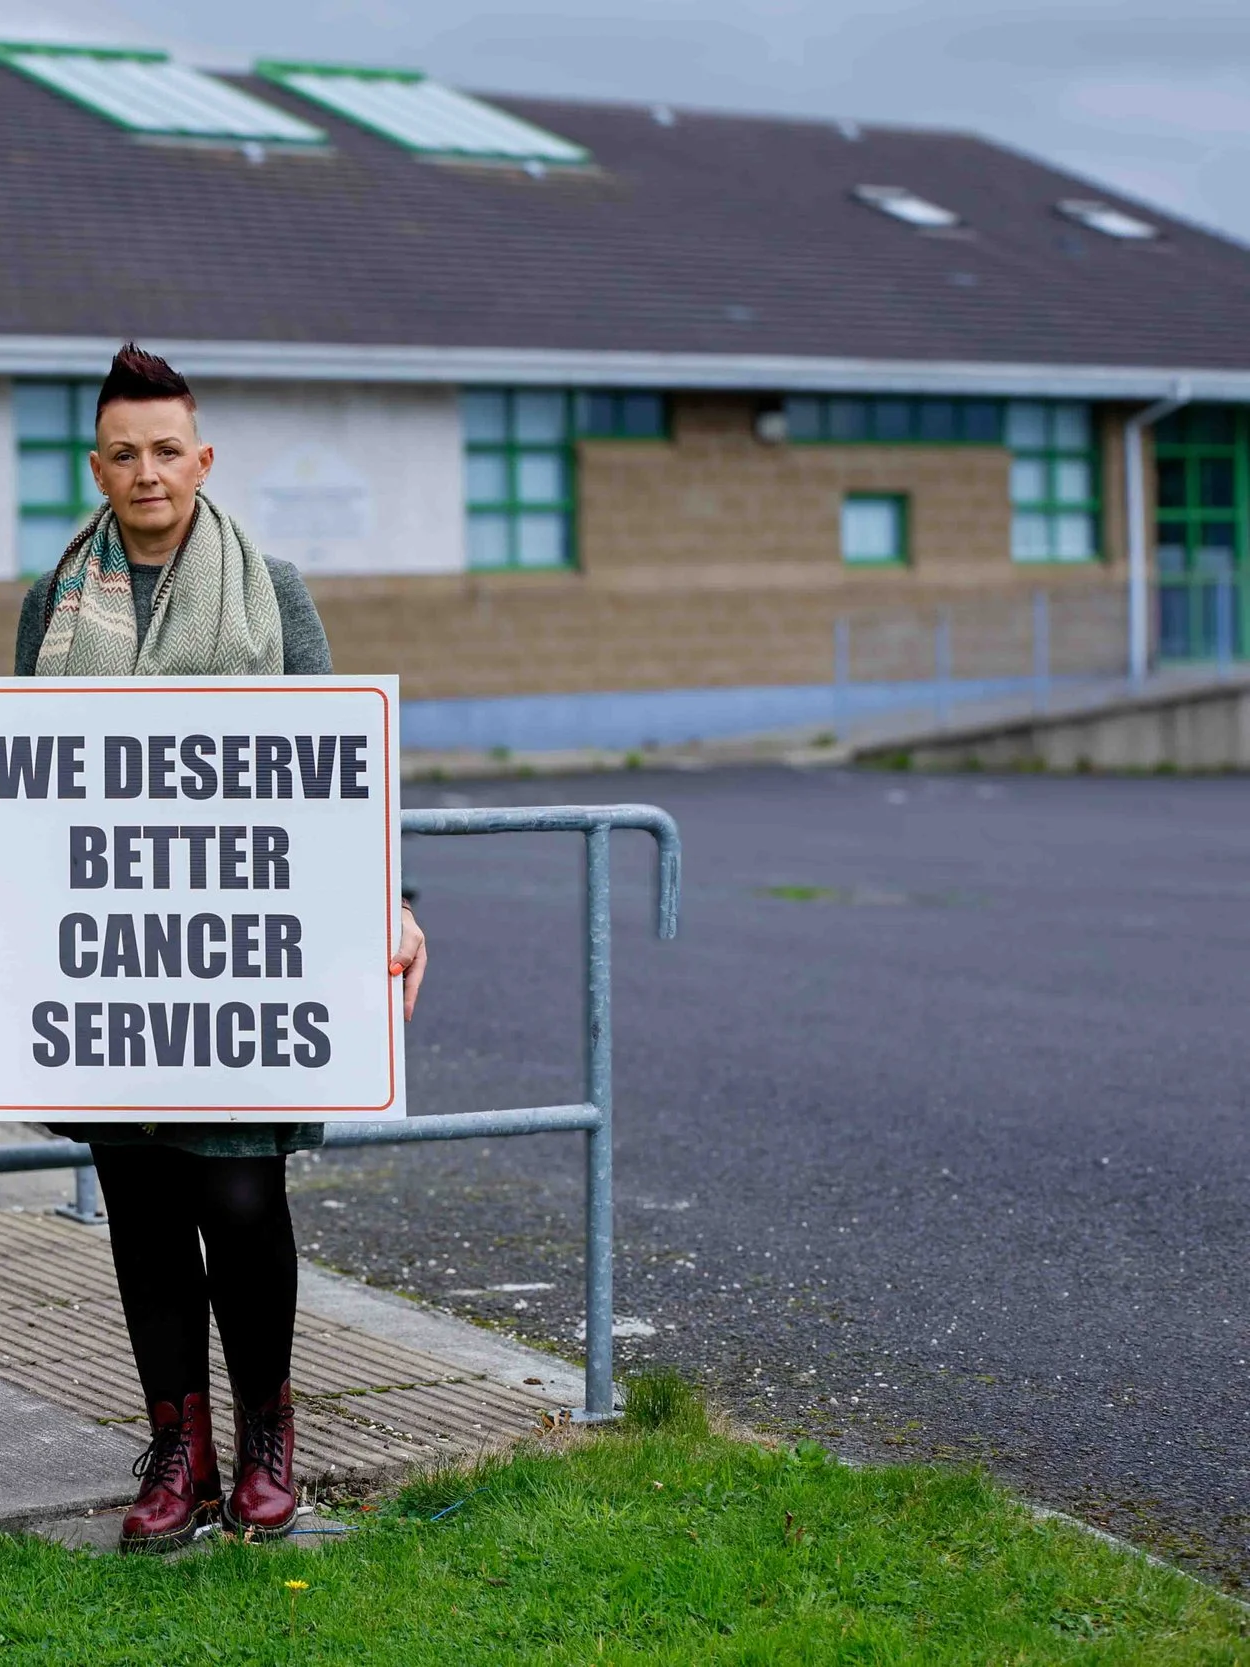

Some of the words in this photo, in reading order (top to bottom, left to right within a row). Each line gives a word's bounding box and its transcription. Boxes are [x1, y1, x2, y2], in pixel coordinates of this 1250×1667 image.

[104, 734, 369, 800] DESERVE
[69, 825, 290, 890] BETTER
[58, 912, 303, 979] CANCER
[31, 1001, 331, 1068] SERVICES
